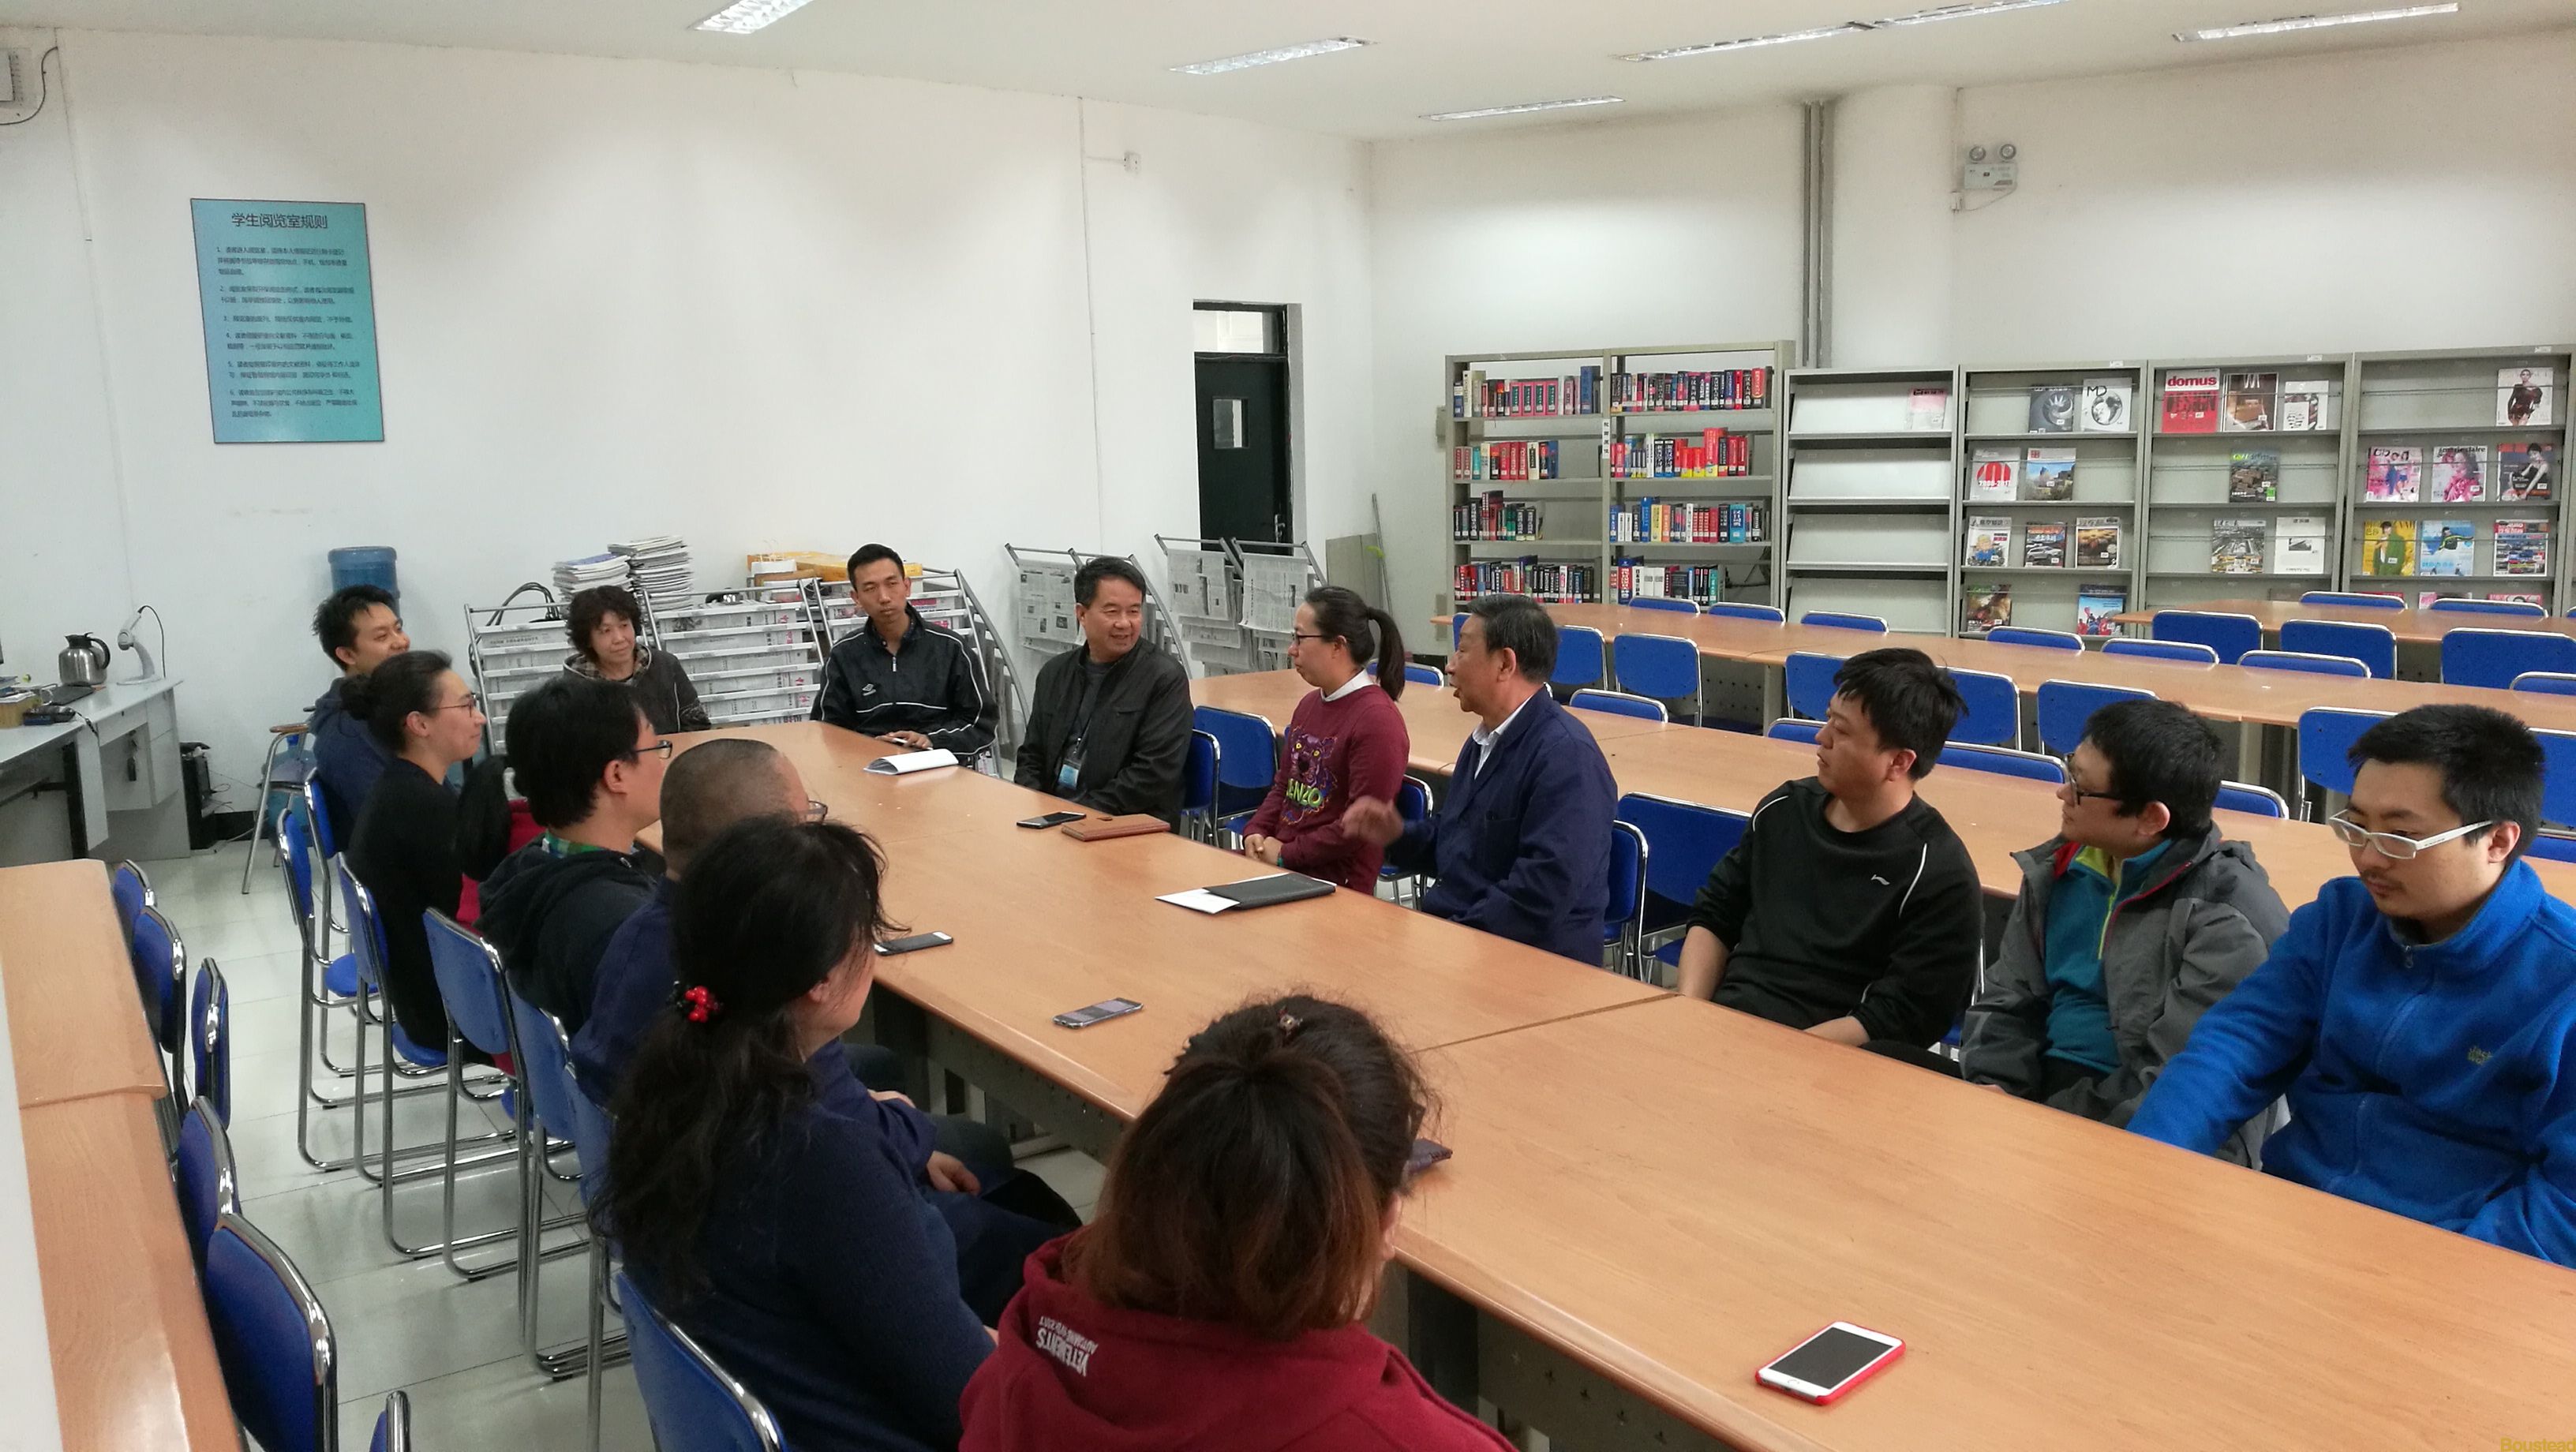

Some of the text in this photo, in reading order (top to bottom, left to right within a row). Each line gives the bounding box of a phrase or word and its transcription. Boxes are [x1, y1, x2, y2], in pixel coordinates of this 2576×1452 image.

[231, 212, 328, 229] 学生阅览室规则
[2167, 376, 2218, 387] domus
[1286, 778, 1324, 807] ENZO
